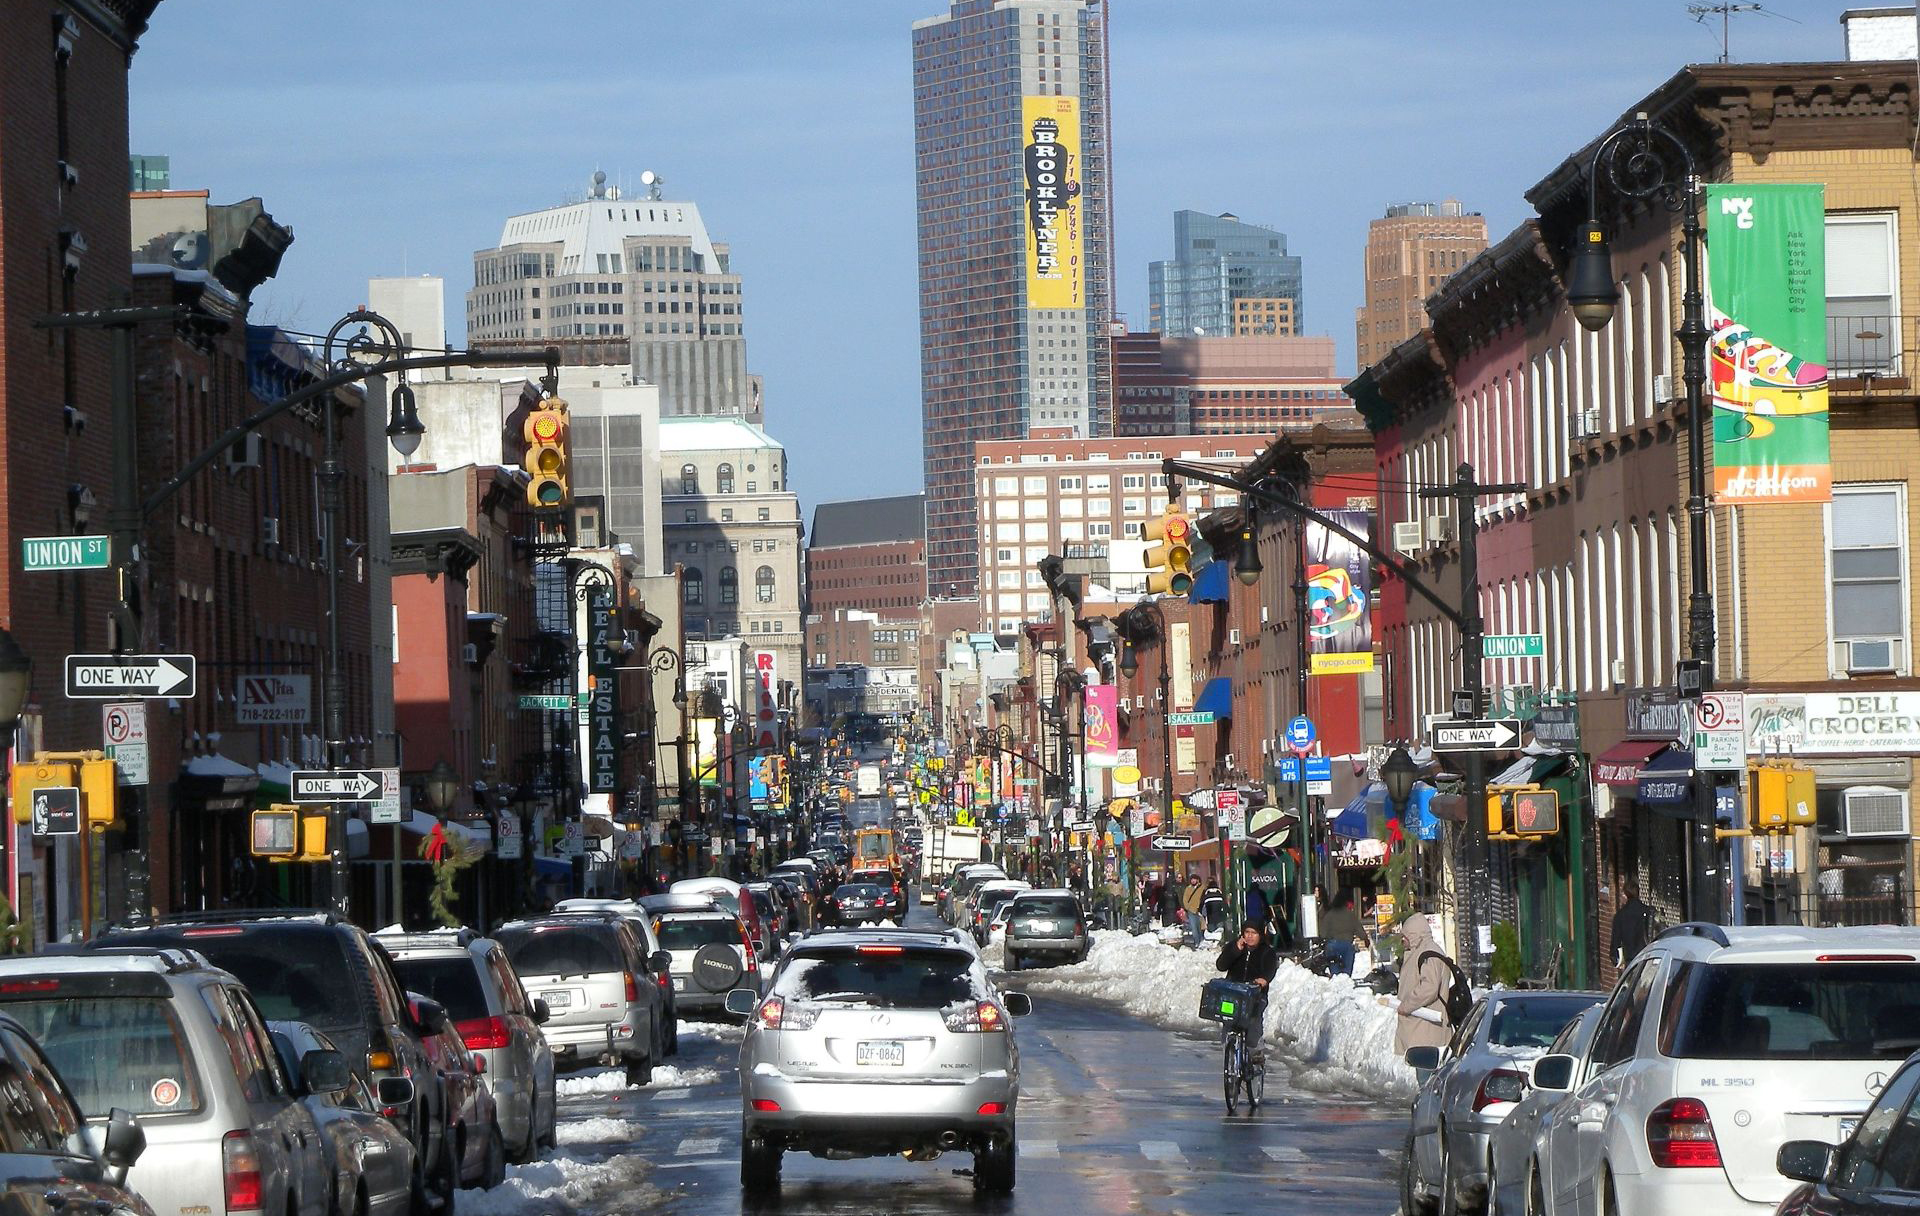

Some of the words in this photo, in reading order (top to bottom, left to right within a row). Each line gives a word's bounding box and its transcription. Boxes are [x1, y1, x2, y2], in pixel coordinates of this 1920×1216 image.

[1035, 131, 1059, 267] BROOKLYNER
[1788, 259, 1804, 267] City
[27, 541, 83, 565] UNION
[89, 540, 103, 553] ST
[593, 594, 612, 665] REAL
[1487, 638, 1526, 655] UNION
[1530, 637, 1540, 646] ST
[1318, 658, 1366, 668] nycgo.com
[80, 668, 114, 684] ONE
[121, 668, 156, 684] WAY
[520, 697, 559, 707] SACKETT
[1838, 696, 1899, 714] DELI
[242, 708, 305, 720] 718-222-1187
[1171, 714, 1205, 723] SACKETT
[595, 677, 614, 788] ESTATE
[1441, 731, 1464, 741] ONE
[1469, 730, 1493, 741] WAY
[1870, 738, 1902, 746] CATERING
[305, 780, 331, 792] ONE
[343, 780, 369, 792] WAY
[1189, 789, 1214, 809] ZOMBIE
[703, 959, 734, 971] HONDA
[859, 1047, 901, 1061] DZF-0862
[1700, 1078, 1719, 1087] ML
[1723, 1078, 1755, 1087] 350
